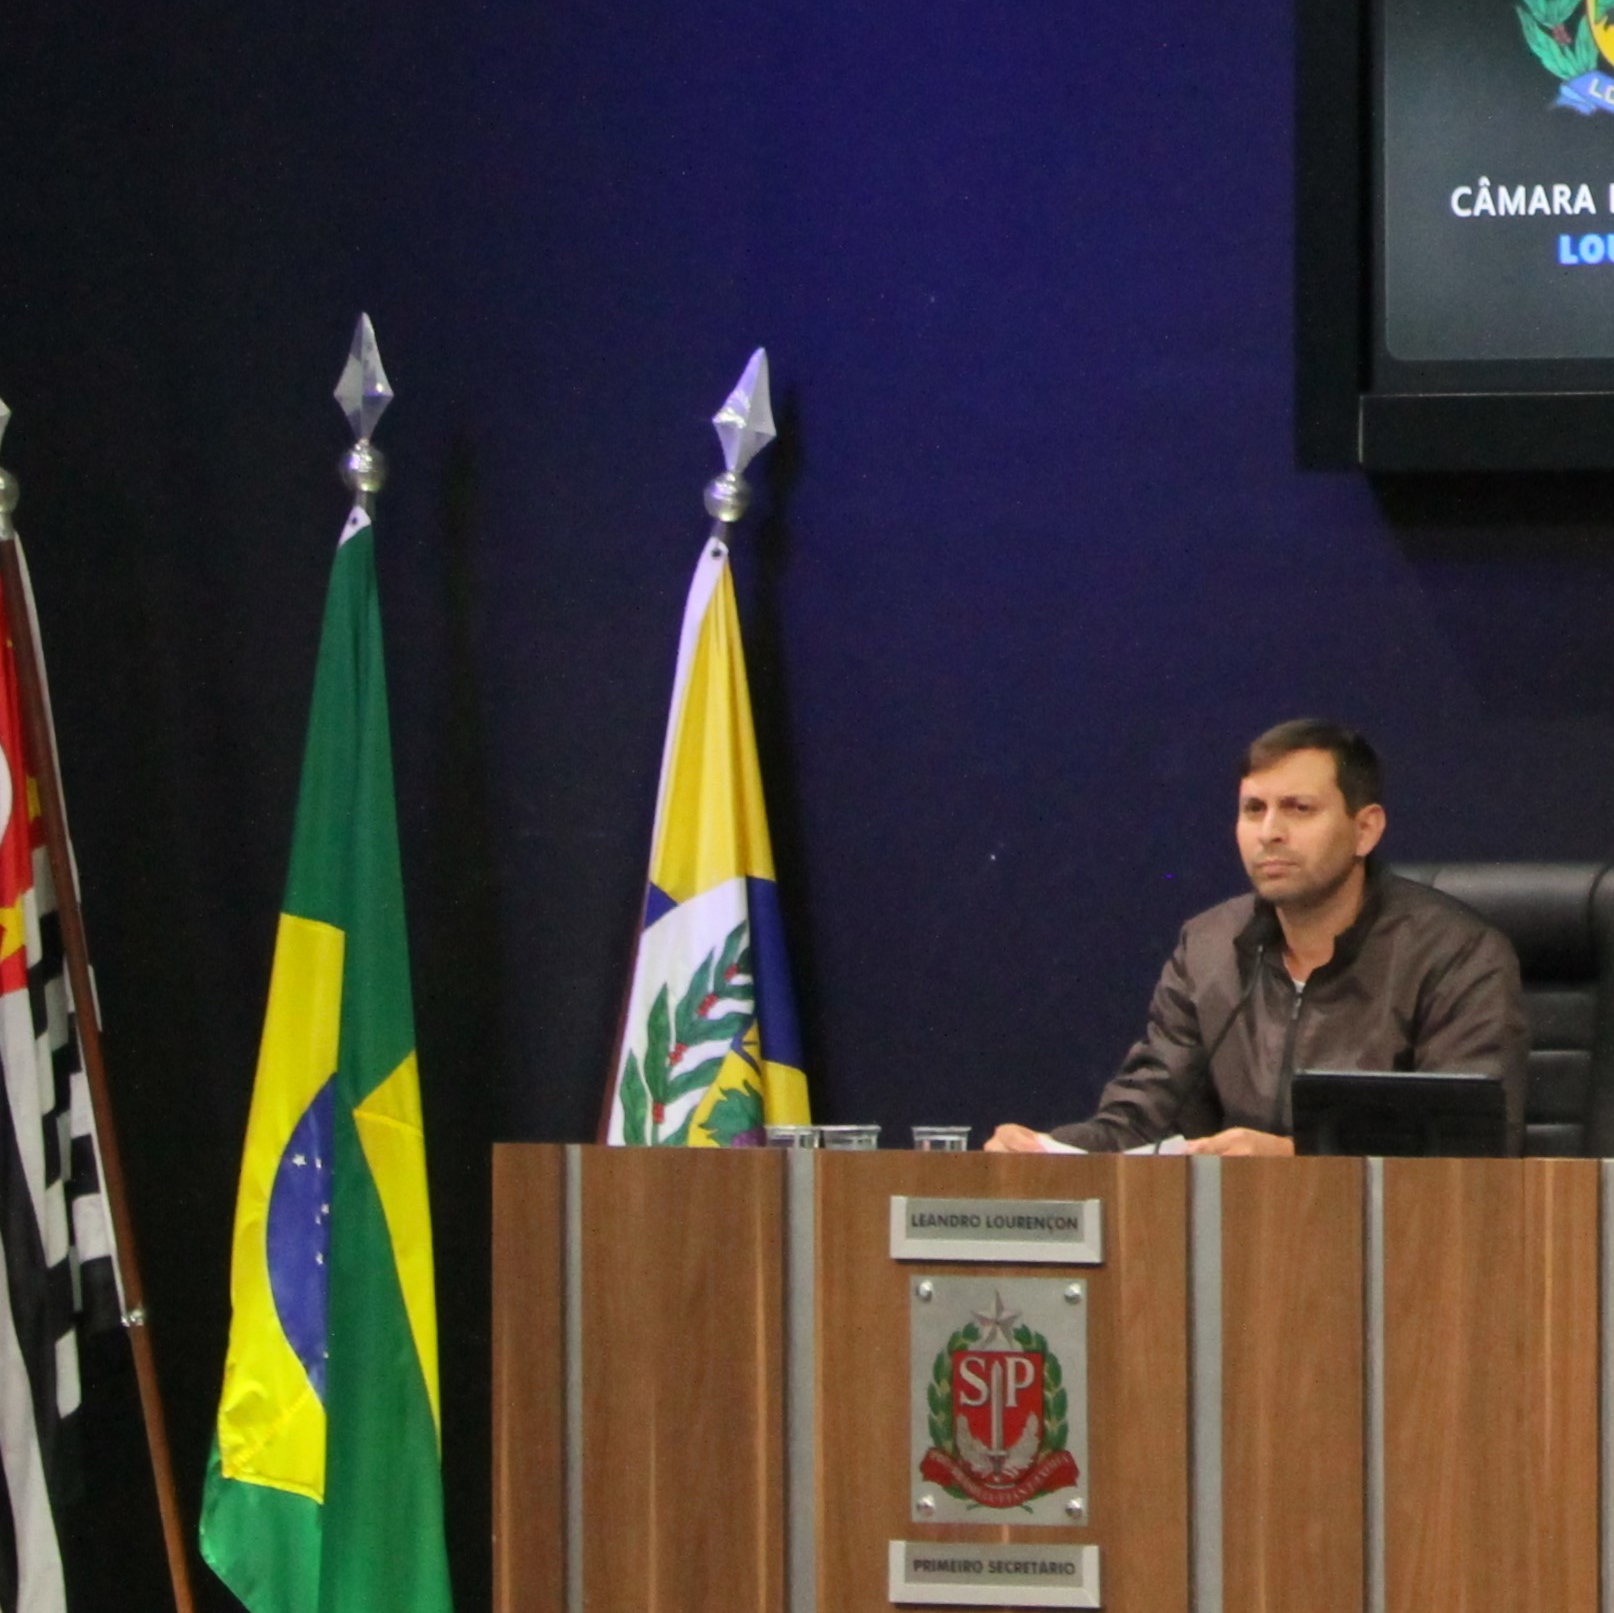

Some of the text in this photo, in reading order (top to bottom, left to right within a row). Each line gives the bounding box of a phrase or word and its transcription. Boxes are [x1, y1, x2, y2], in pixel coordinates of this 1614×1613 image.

[1451, 176, 1595, 217] CÂMARA
[912, 1214, 980, 1228] LEANDRO
[913, 1559, 984, 1573] PRIMEIRO
